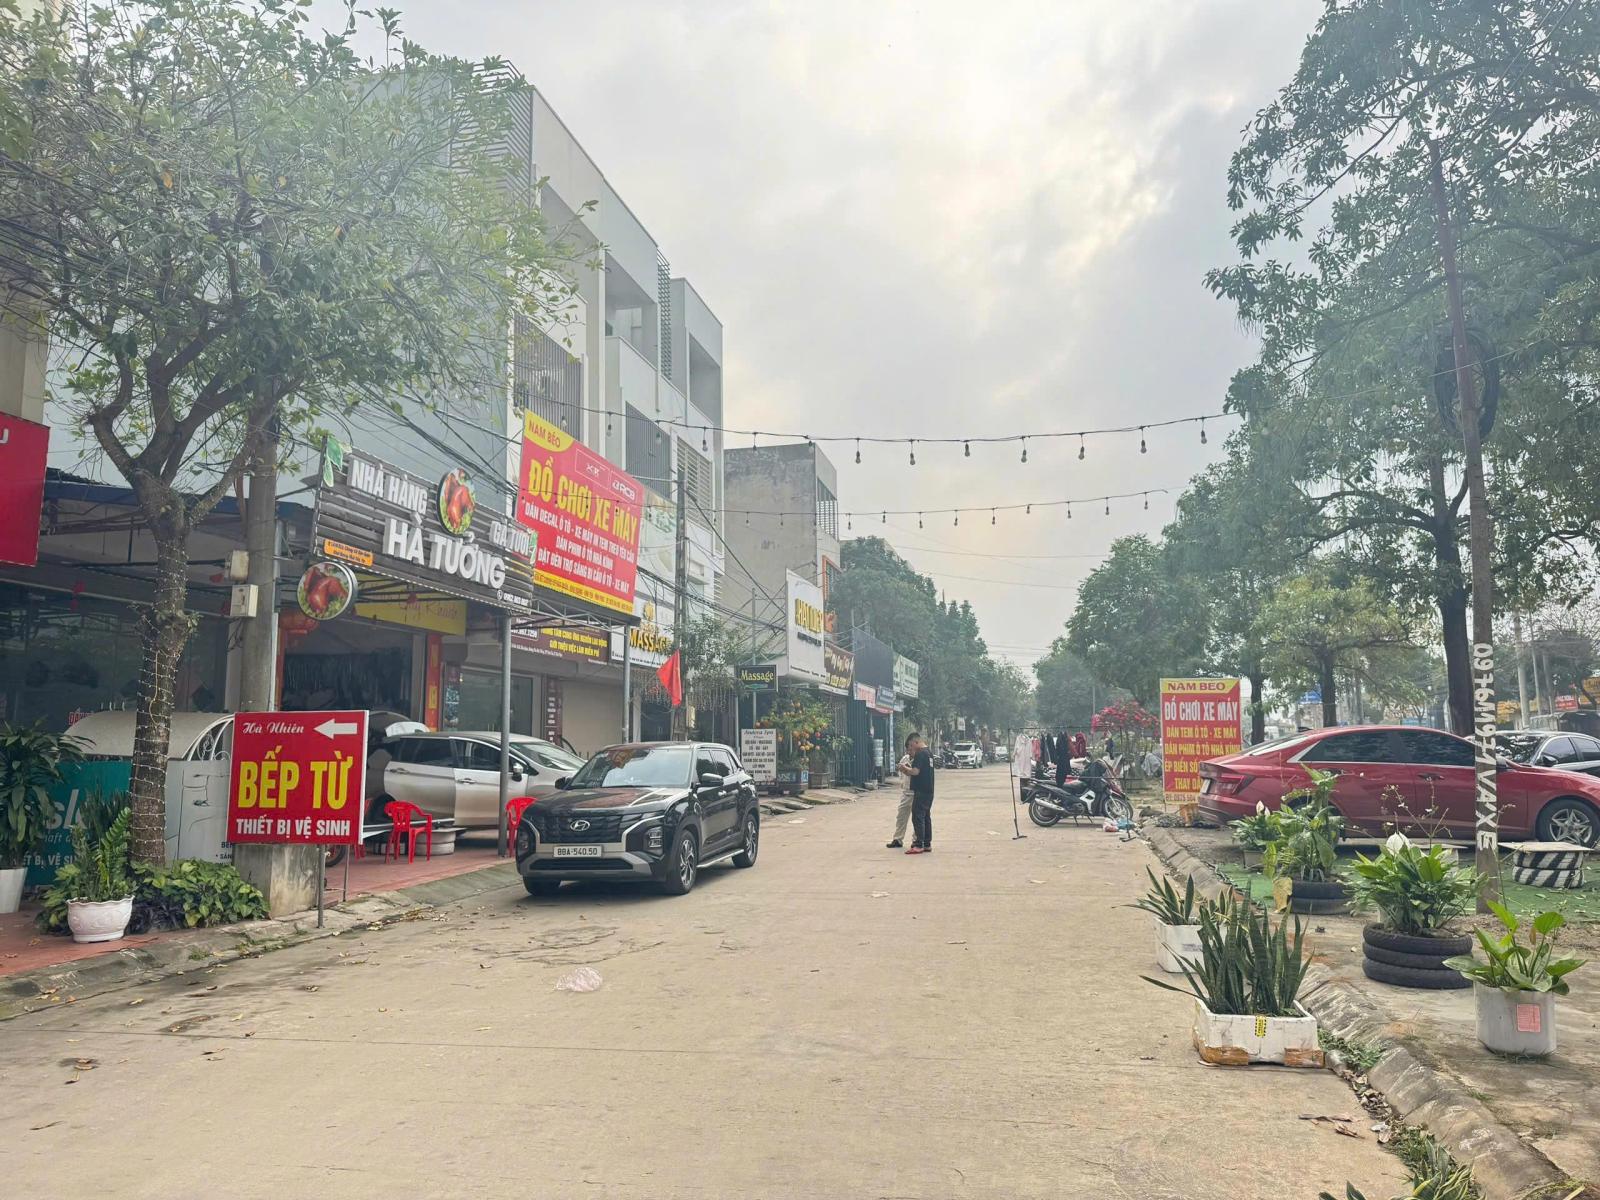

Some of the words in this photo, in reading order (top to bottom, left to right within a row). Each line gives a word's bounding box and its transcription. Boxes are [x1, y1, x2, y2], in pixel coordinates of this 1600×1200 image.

[529, 420, 546, 439] NAM
[349, 462, 384, 499] NHÀ
[387, 474, 428, 515] HÀNG
[539, 508, 559, 529] DECAL
[557, 475, 592, 522] CHƠI
[593, 496, 611, 531] XE
[613, 506, 638, 545] MÁY
[384, 511, 425, 565] HÀ
[429, 531, 505, 588] TƯỞNG
[741, 669, 774, 683] Massage
[1168, 682, 1196, 691] NAM
[1180, 700, 1200, 721] CHƠI
[1203, 701, 1215, 721] XE
[1217, 697, 1238, 721] MÁY
[242, 722, 262, 734] Hà
[267, 721, 304, 734] Nhiên
[1213, 727, 1223, 738] XE
[237, 745, 300, 809] BẾP
[310, 750, 354, 810] TỪ
[236, 814, 273, 836] THIẾT
[277, 819, 291, 839] BỊ
[295, 816, 312, 839] VỆ
[316, 820, 351, 836] SINH
